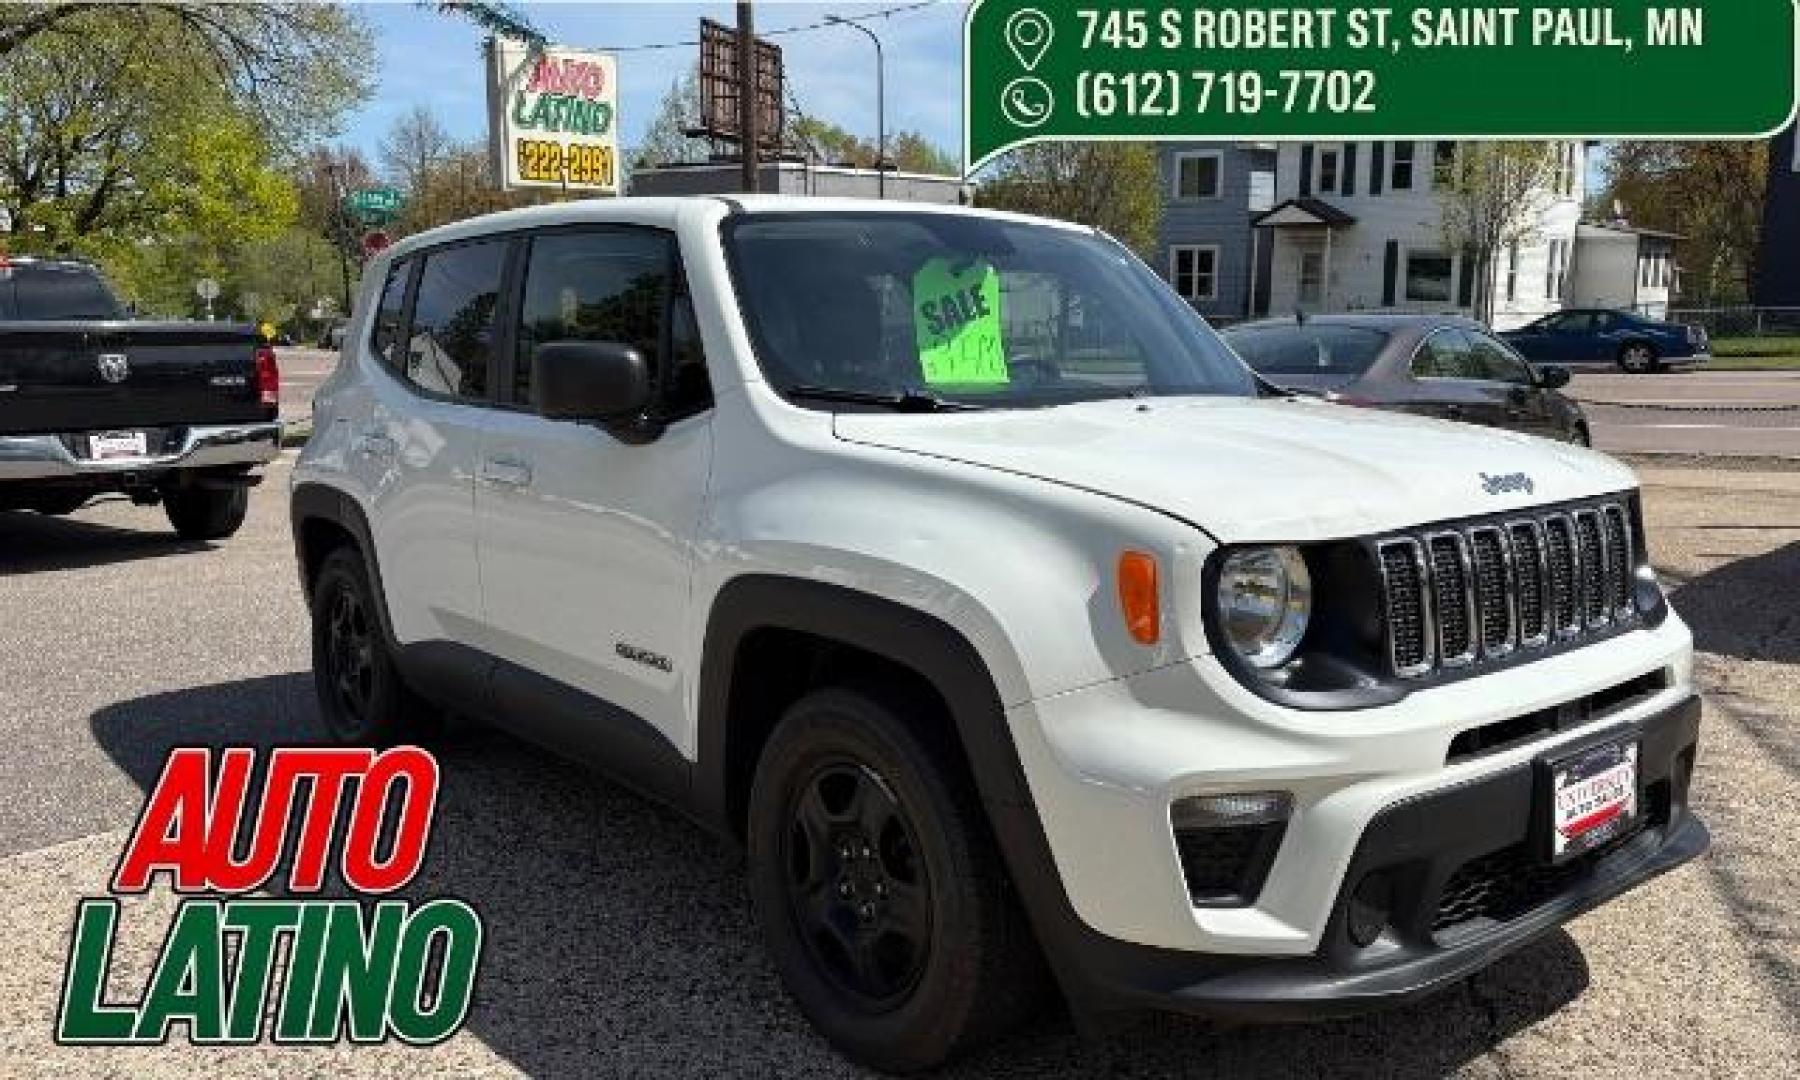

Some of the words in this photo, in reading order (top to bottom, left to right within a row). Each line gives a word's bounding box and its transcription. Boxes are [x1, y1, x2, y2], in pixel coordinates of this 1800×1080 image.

[527, 55, 606, 100] AUTO
[512, 90, 614, 135] LATINO
[921, 283, 991, 336] SALE
